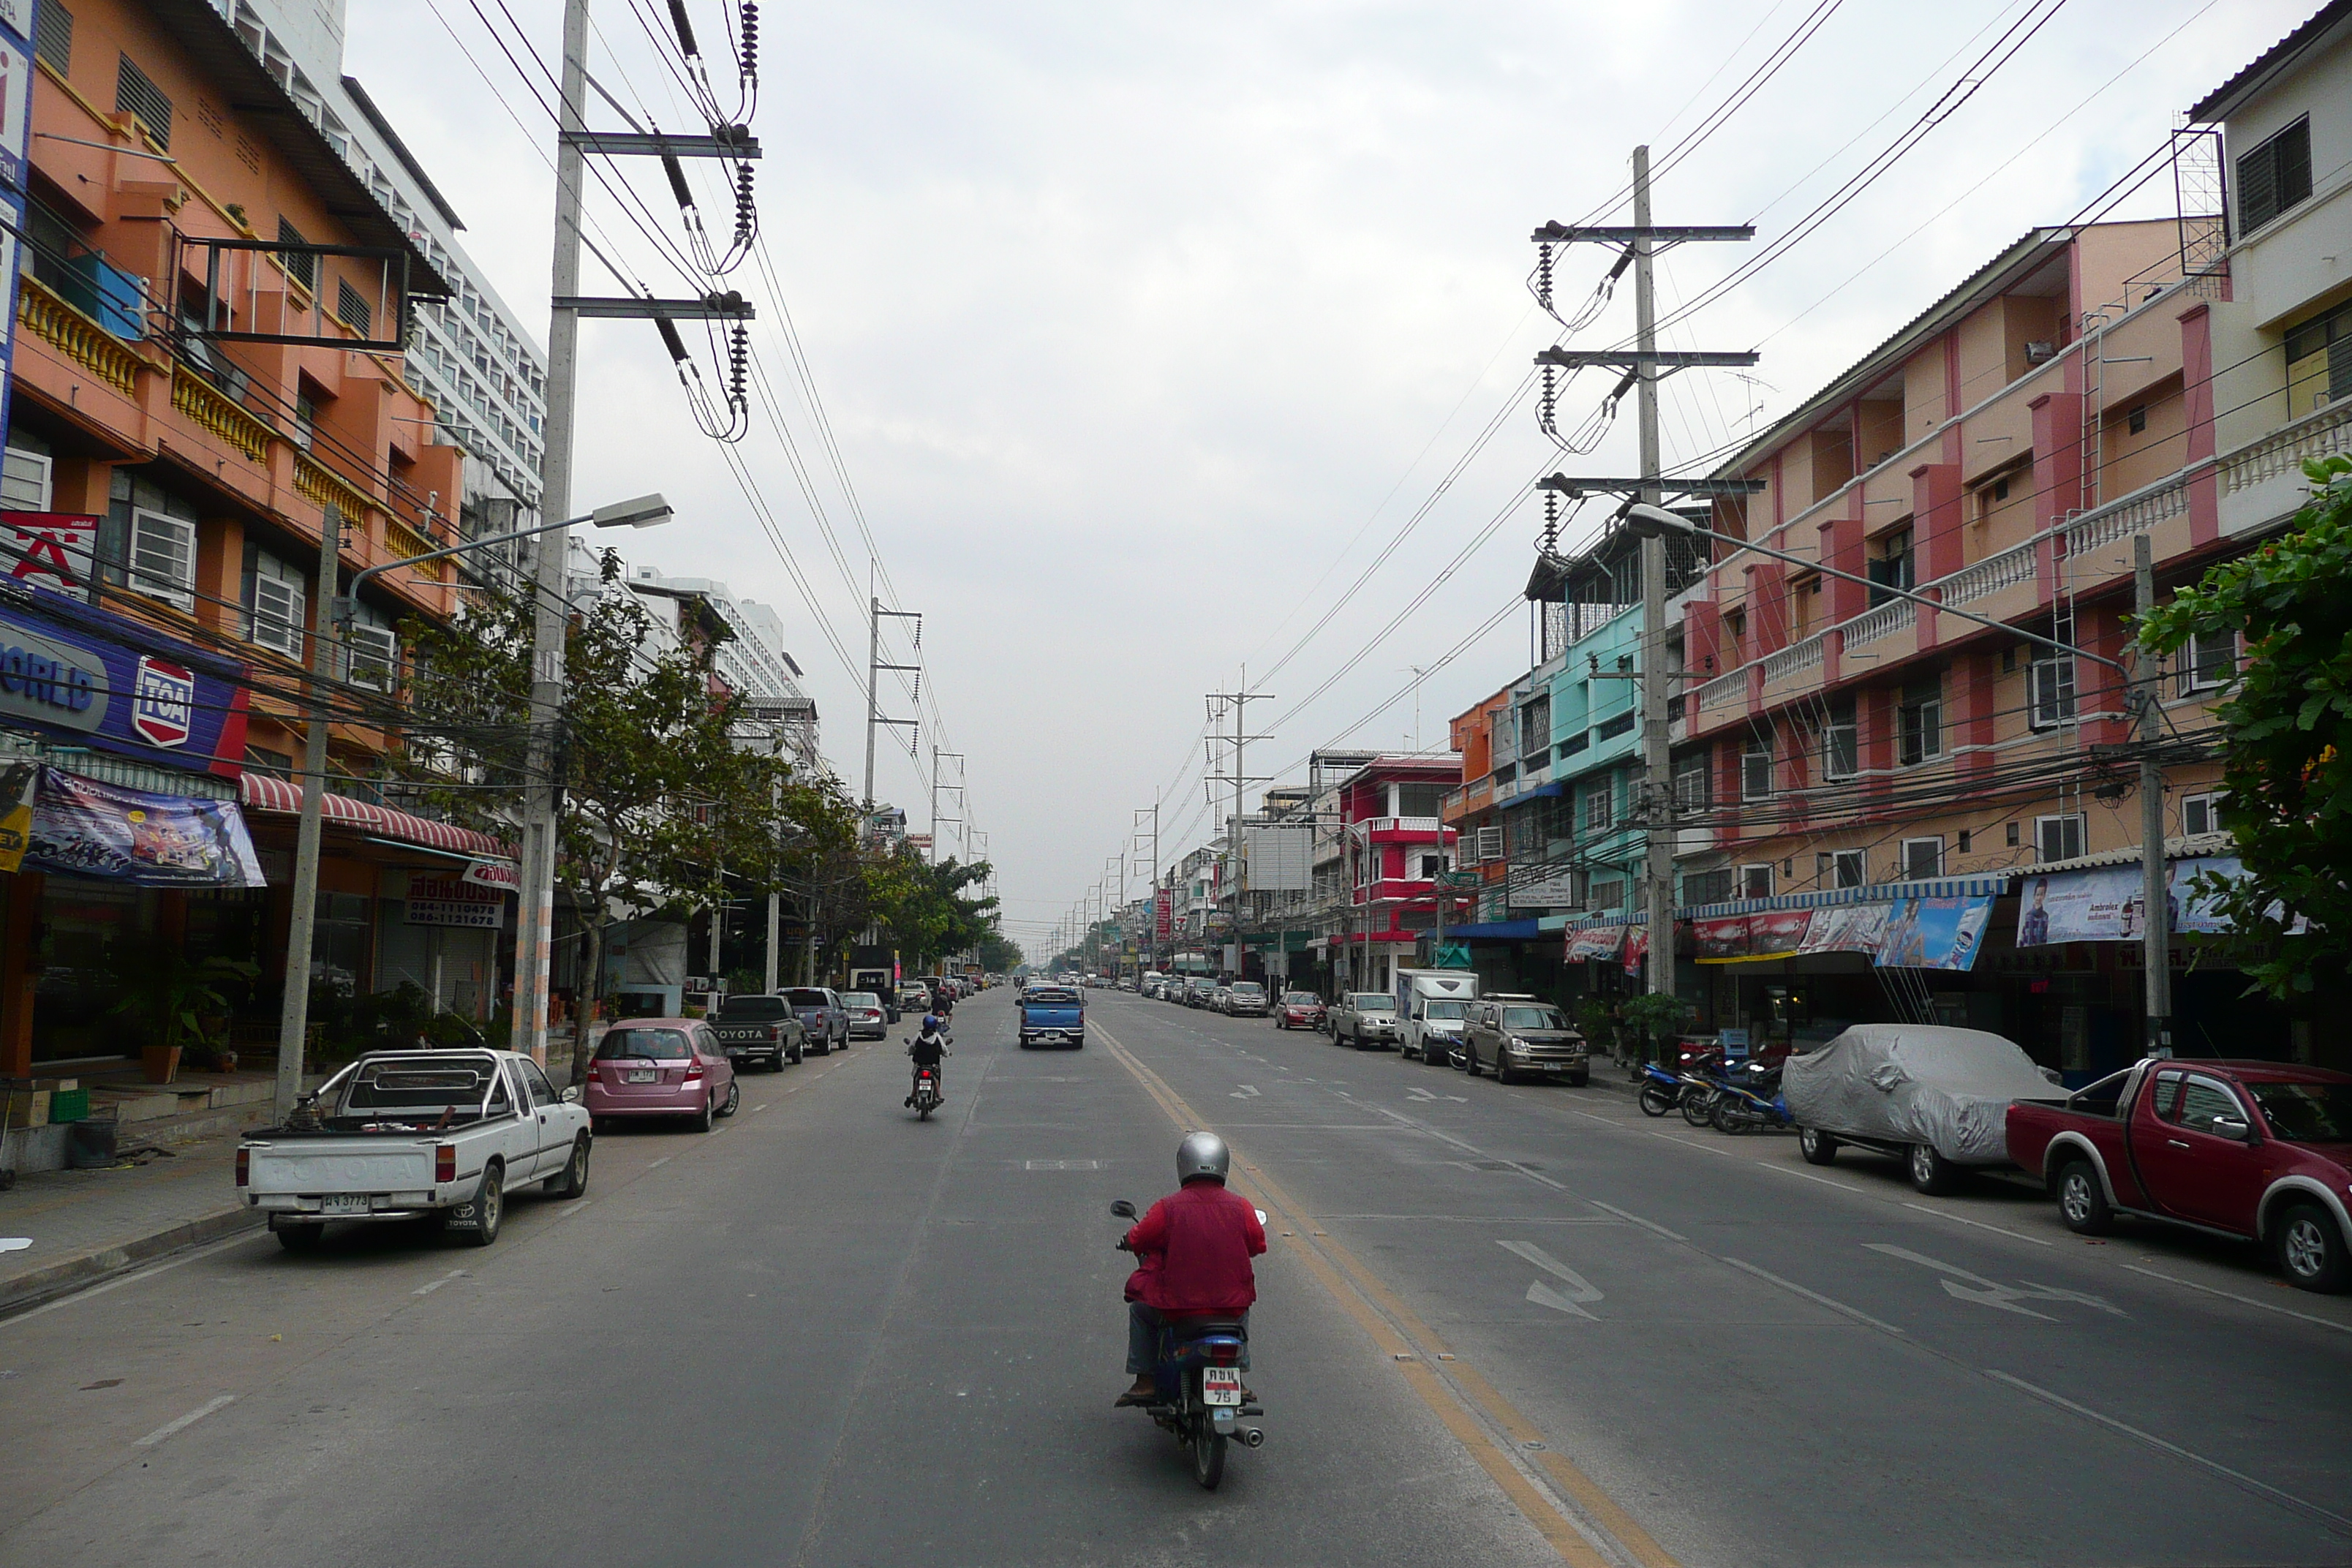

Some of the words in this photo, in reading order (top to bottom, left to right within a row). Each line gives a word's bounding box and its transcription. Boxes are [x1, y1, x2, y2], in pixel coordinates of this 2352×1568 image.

[0, 642, 94, 711] ORLD
[144, 676, 186, 723] TOA
[411, 912, 494, 925] 086-1121678
[343, 1196, 367, 1206] 3773
[1215, 1390, 1231, 1403] 75
